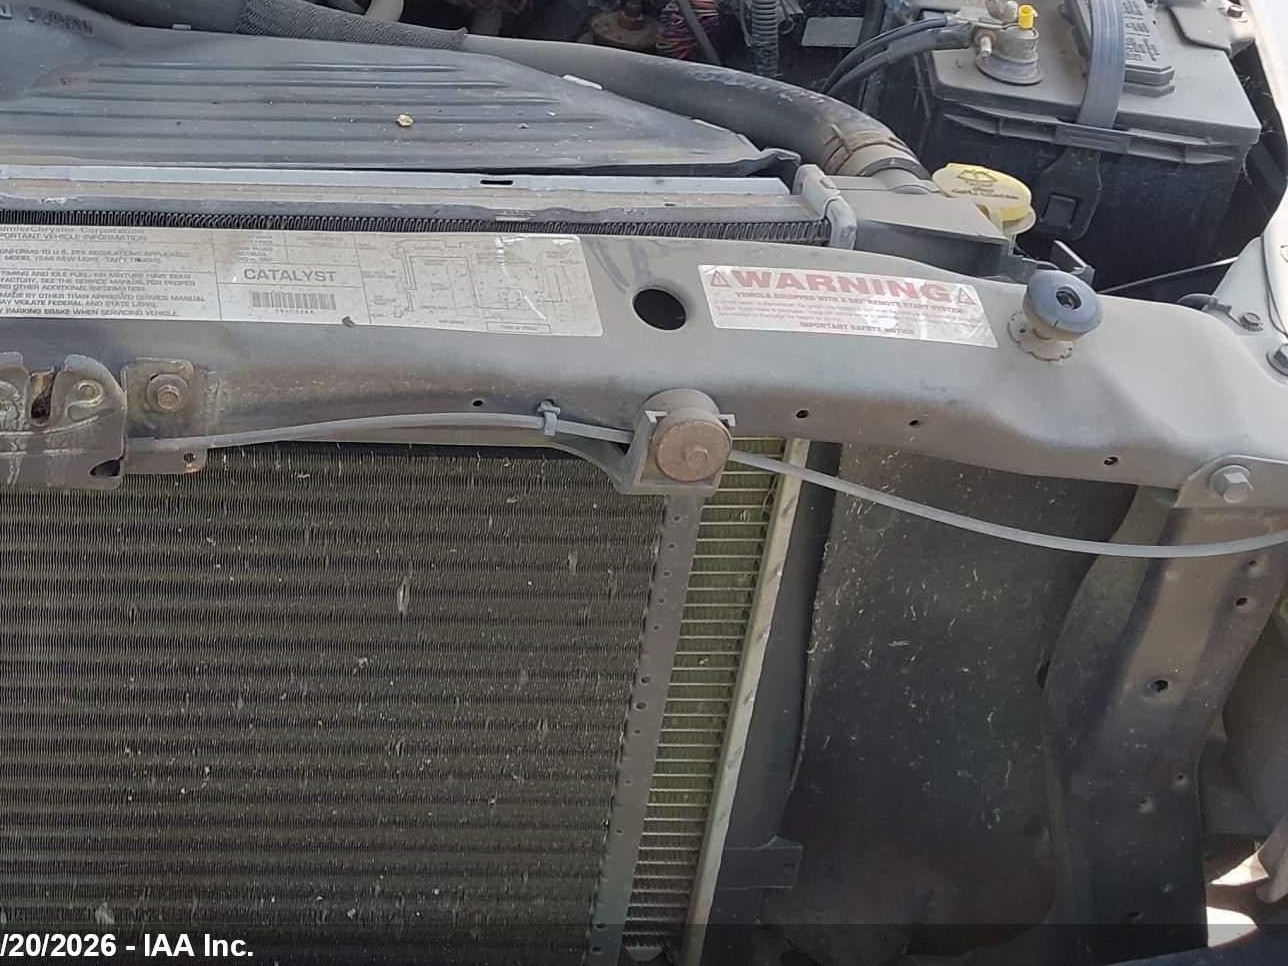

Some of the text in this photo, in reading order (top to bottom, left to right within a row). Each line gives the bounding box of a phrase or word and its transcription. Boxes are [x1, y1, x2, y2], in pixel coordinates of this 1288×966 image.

[243, 268, 337, 283] CATALYST
[729, 269, 953, 303] WARNING
[5, 307, 41, 315] PARKING
[799, 321, 849, 330] IMPORTANT
